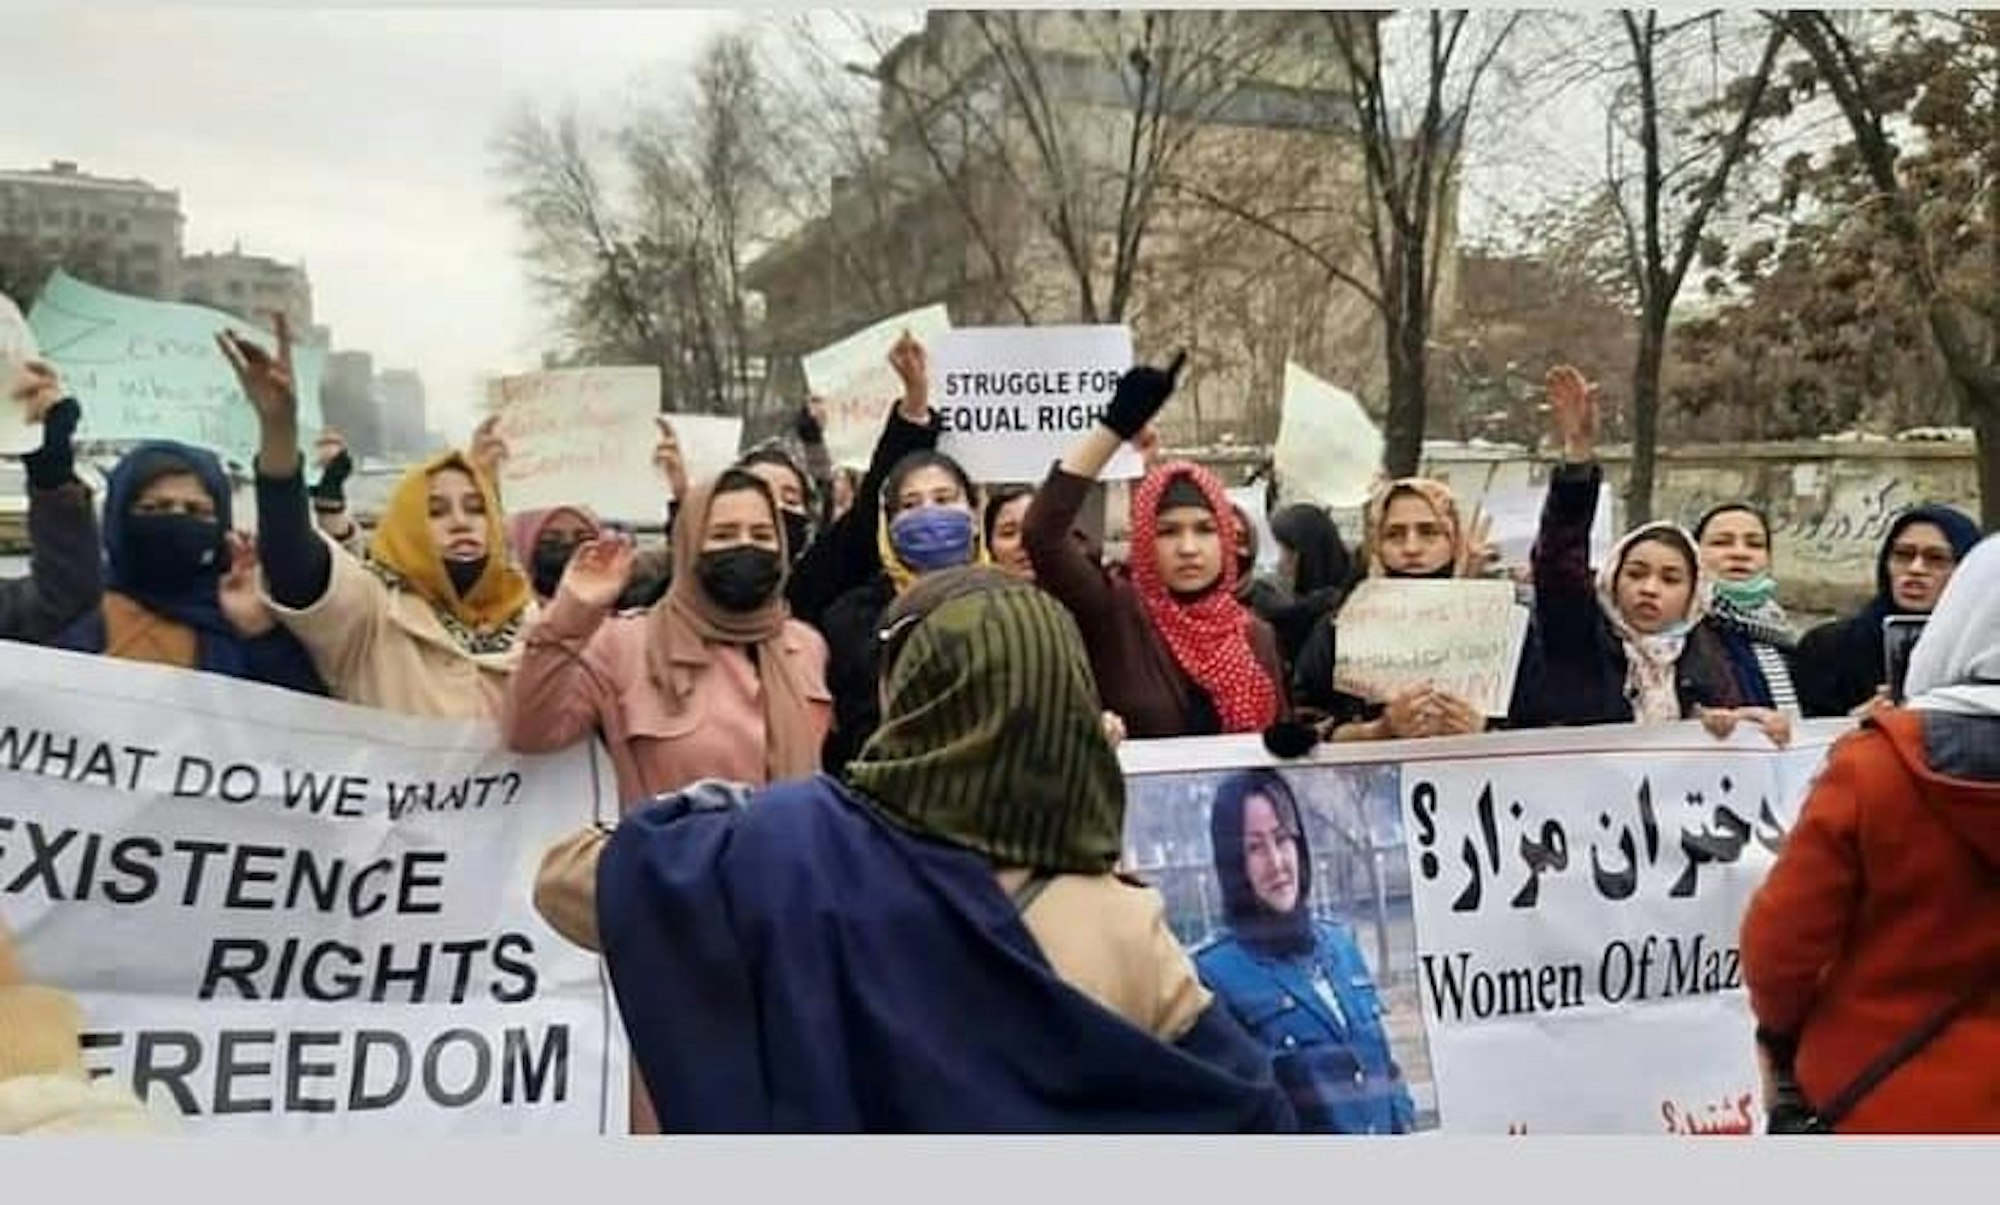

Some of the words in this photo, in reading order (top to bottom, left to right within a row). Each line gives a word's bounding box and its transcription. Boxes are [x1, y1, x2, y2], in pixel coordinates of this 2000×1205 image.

[938, 406, 1028, 433] EQUAL
[1038, 405, 1110, 431] RIGH
[946, 371, 1070, 396] STRUGGLE
[1078, 370, 1117, 393] FOR
[0, 726, 159, 791] WHAT
[172, 755, 261, 805] DO
[282, 769, 369, 819] WE
[1412, 780, 1569, 913] مزار؟
[1591, 776, 1785, 899] دختران
[198, 933, 539, 1005] RIGHTS
[1422, 951, 1585, 1022] Women
[1599, 936, 1658, 1003] Of
[1661, 933, 1740, 999] Maz
